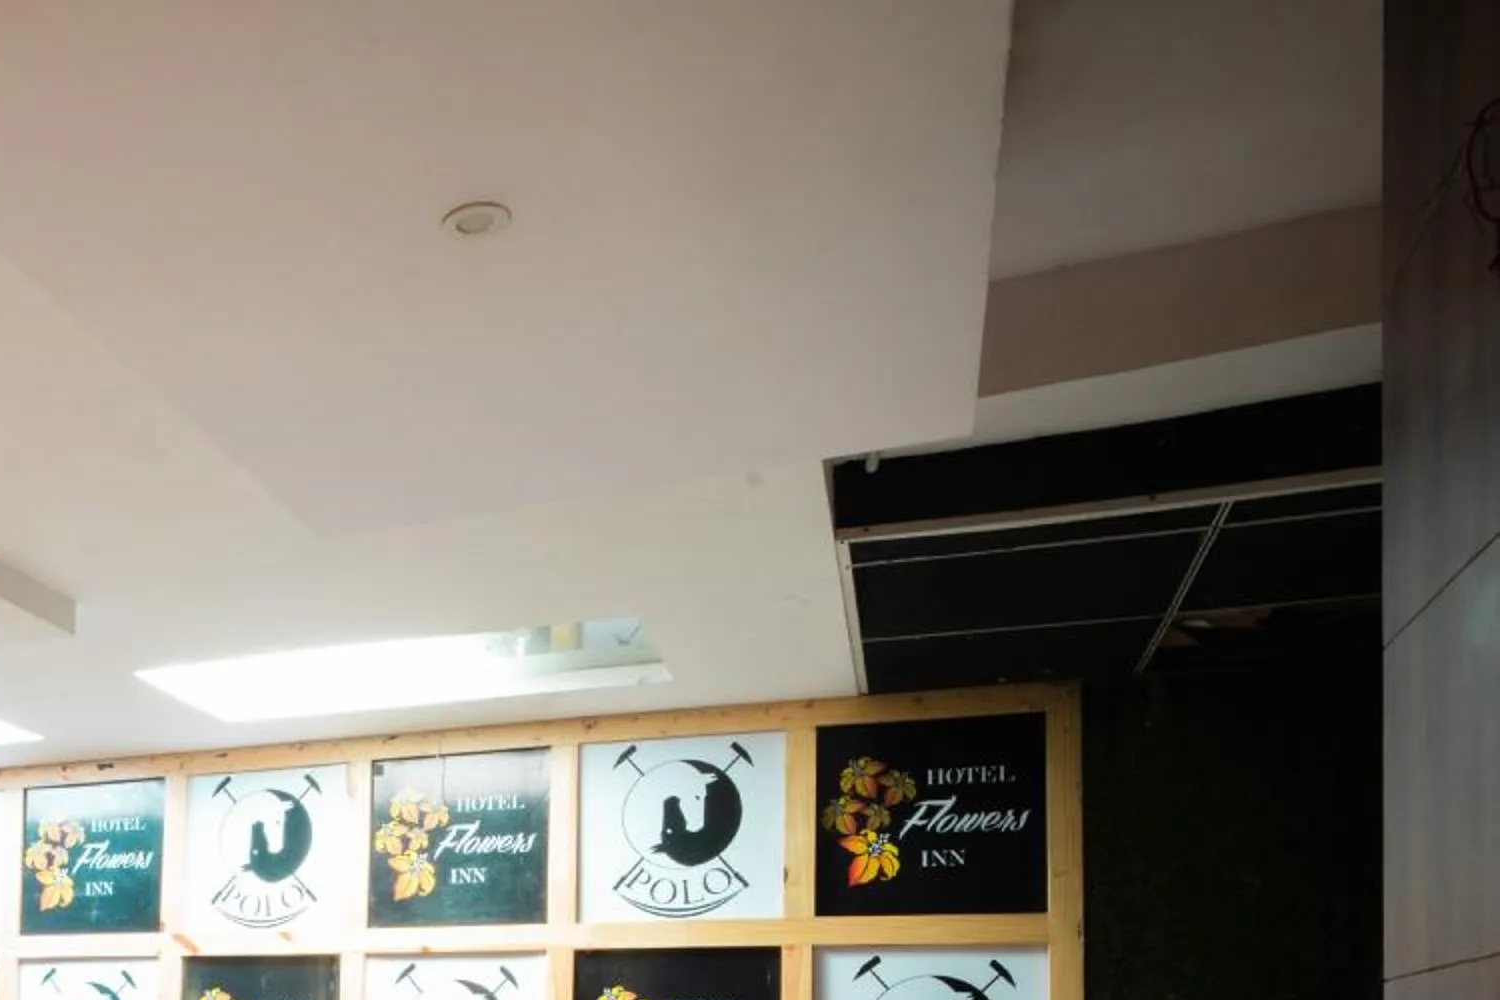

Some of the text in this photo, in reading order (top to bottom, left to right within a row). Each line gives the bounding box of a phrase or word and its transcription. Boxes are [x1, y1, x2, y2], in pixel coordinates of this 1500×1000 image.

[927, 765, 1016, 785] HOTEL
[456, 794, 525, 812] HOTEL
[90, 815, 145, 832] HOTEL
[898, 795, 1029, 840] Flowers
[433, 820, 536, 861] Flowers
[71, 839, 154, 875] Flowers
[921, 849, 965, 868] INN
[450, 866, 487, 885] INN
[84, 880, 115, 897] INN
[626, 868, 731, 904] POLO
